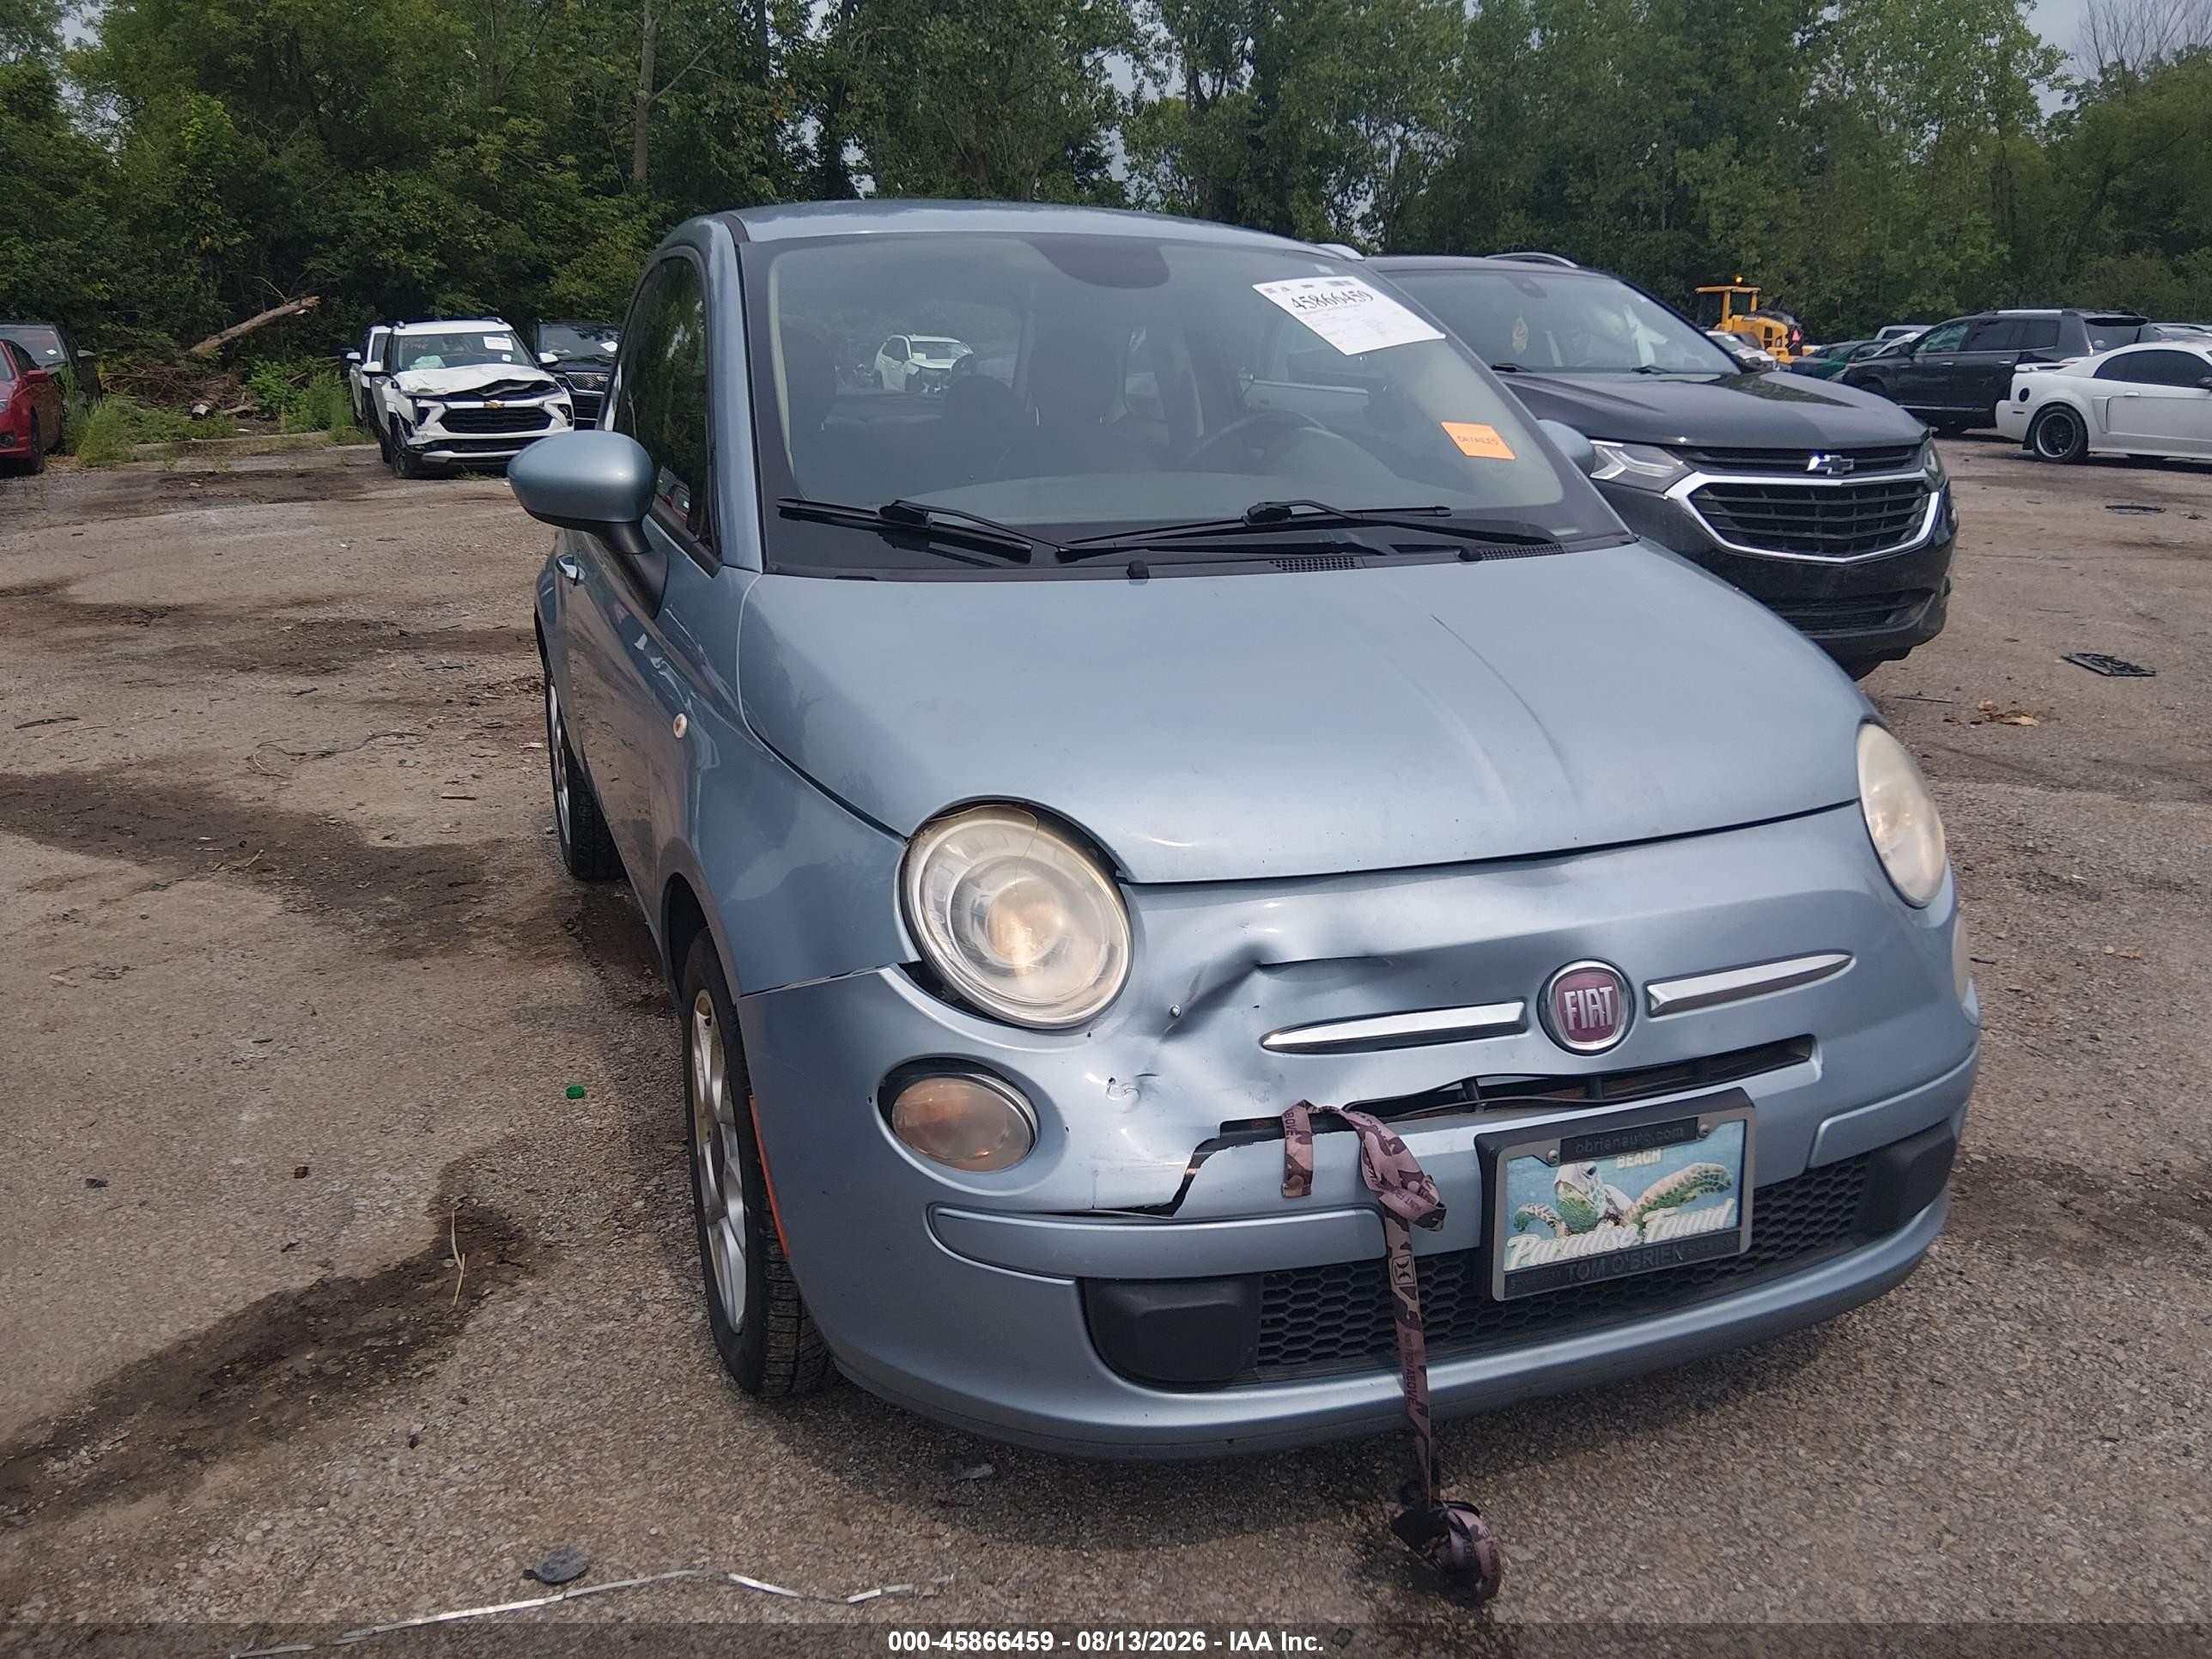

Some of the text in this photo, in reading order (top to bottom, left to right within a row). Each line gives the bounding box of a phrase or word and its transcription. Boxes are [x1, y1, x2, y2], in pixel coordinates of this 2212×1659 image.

[1291, 290, 1374, 310] 45866459
[1564, 986, 1614, 1031] FIAT
[1575, 1127, 1683, 1154] obrienauto.com
[1616, 1149, 1662, 1169] BEACH
[1506, 1224, 1638, 1270] Paradise
[1642, 1199, 1735, 1243] Found
[1565, 1260, 1604, 1281] TOM
[1611, 1245, 1683, 1273] O'BRIEN
